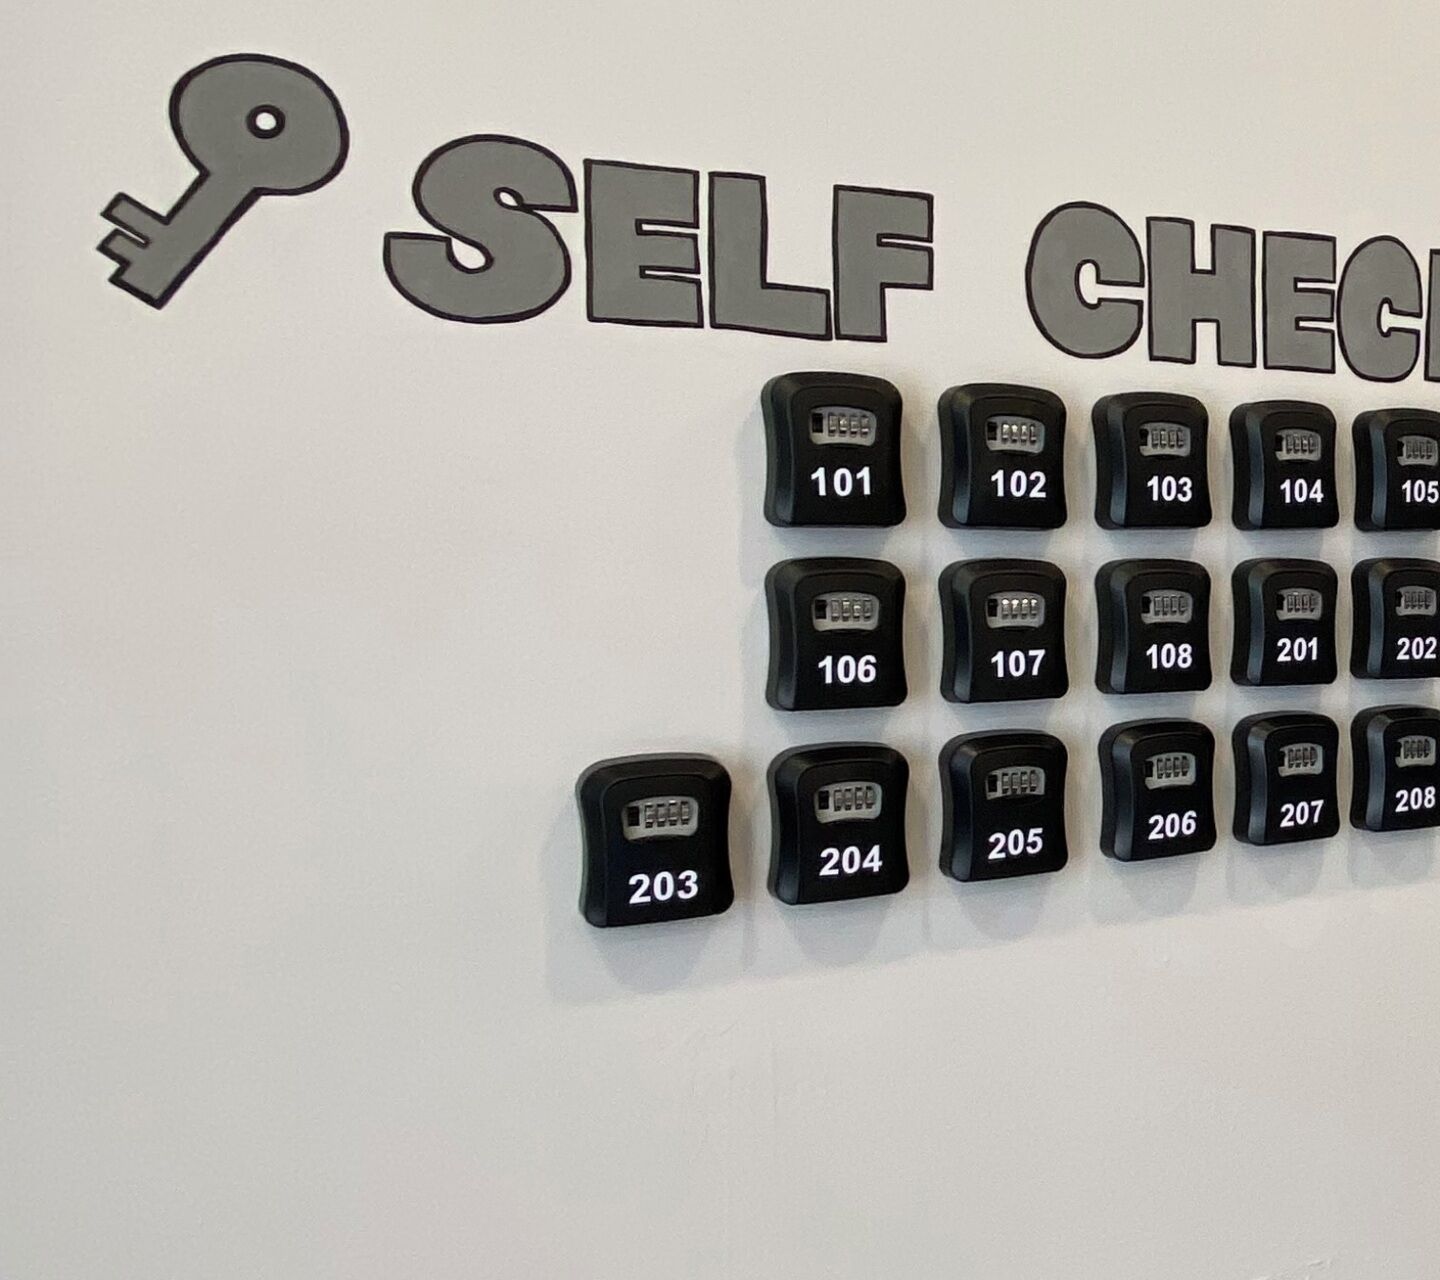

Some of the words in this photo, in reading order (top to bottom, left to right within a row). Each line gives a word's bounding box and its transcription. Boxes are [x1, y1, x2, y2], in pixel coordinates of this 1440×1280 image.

[383, 133, 935, 343] SELF
[811, 467, 872, 497] 101
[990, 469, 1047, 498] 102
[1147, 475, 1193, 502] 103
[1280, 478, 1324, 504] 104
[1401, 479, 1440, 504] 105
[1146, 642, 1193, 669] 108
[1276, 636, 1319, 662] 201
[1396, 636, 1437, 660] 202
[818, 654, 877, 684] 106
[991, 649, 1046, 677] 107
[1279, 799, 1324, 827] 207
[1395, 786, 1436, 812] 208
[1148, 810, 1197, 840] 206
[987, 827, 1044, 860] 205
[819, 844, 883, 876] 204
[628, 869, 699, 904] 203
